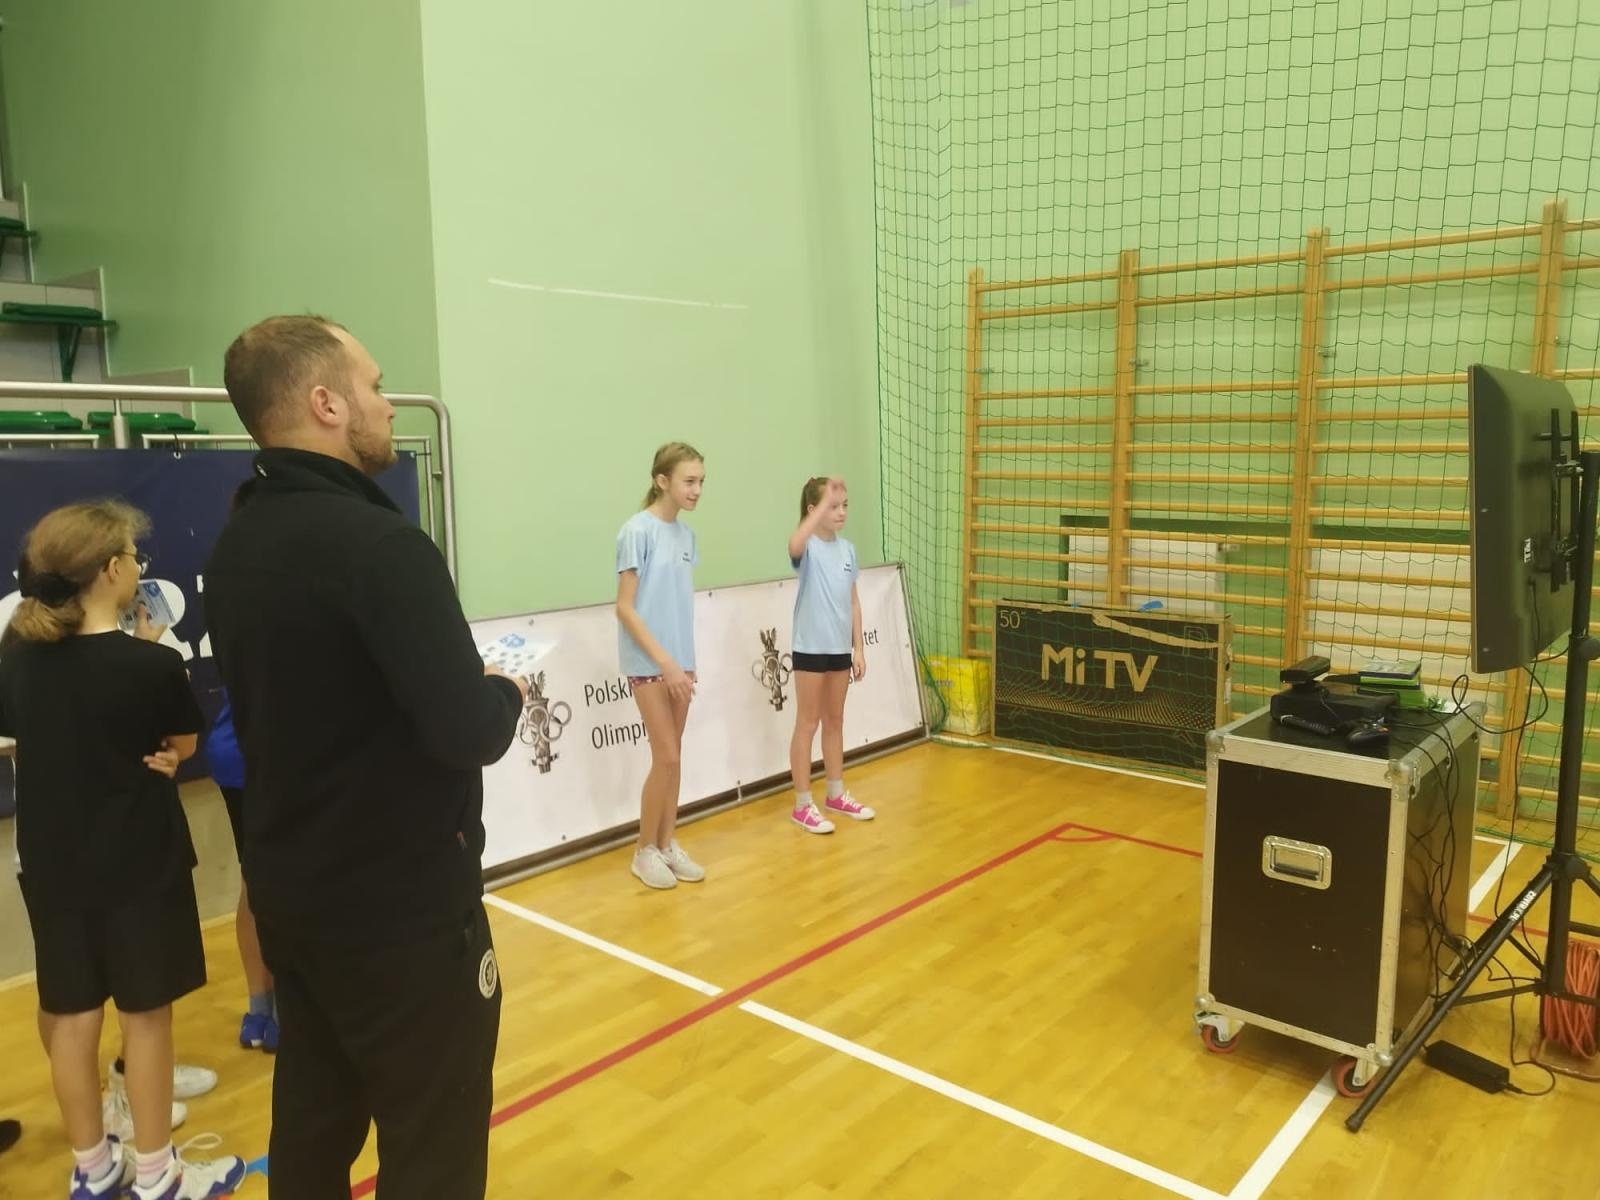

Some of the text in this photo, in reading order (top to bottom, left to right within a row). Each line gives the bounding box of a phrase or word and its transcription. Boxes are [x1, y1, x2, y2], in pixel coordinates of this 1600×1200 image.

[1041, 643, 1159, 692] Mi TV
[591, 721, 648, 750] Olimpi
